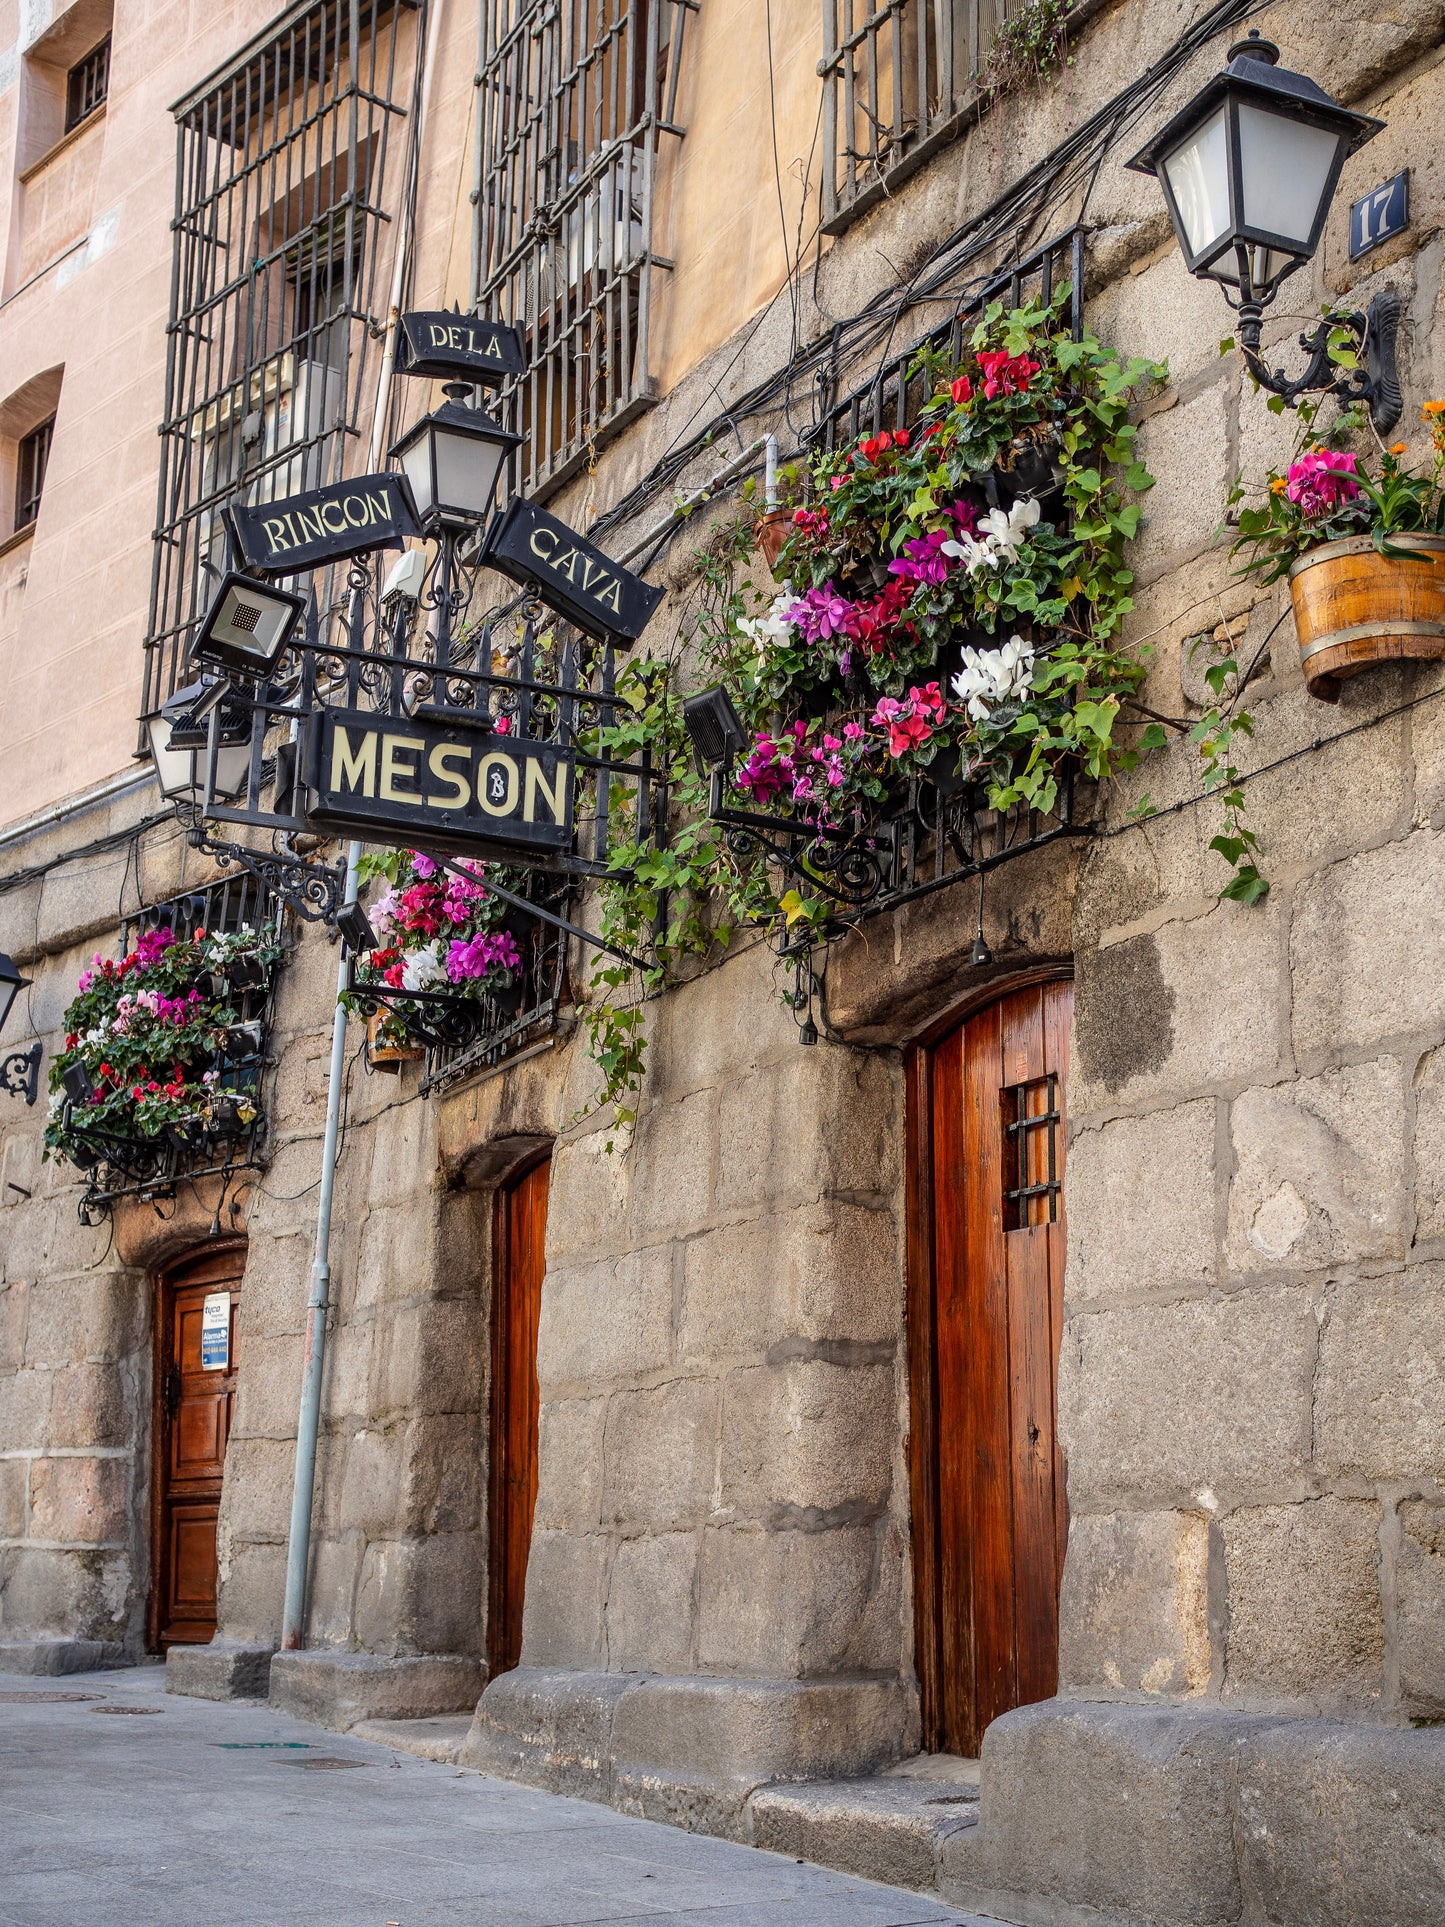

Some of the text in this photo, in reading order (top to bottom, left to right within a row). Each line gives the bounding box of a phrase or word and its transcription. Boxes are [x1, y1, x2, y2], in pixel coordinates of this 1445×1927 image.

[1359, 183, 1395, 248] 17
[429, 324, 503, 359] DE LA
[261, 489, 393, 554] RINCON
[529, 527, 622, 616] CAVA
[329, 725, 568, 827] MESON
